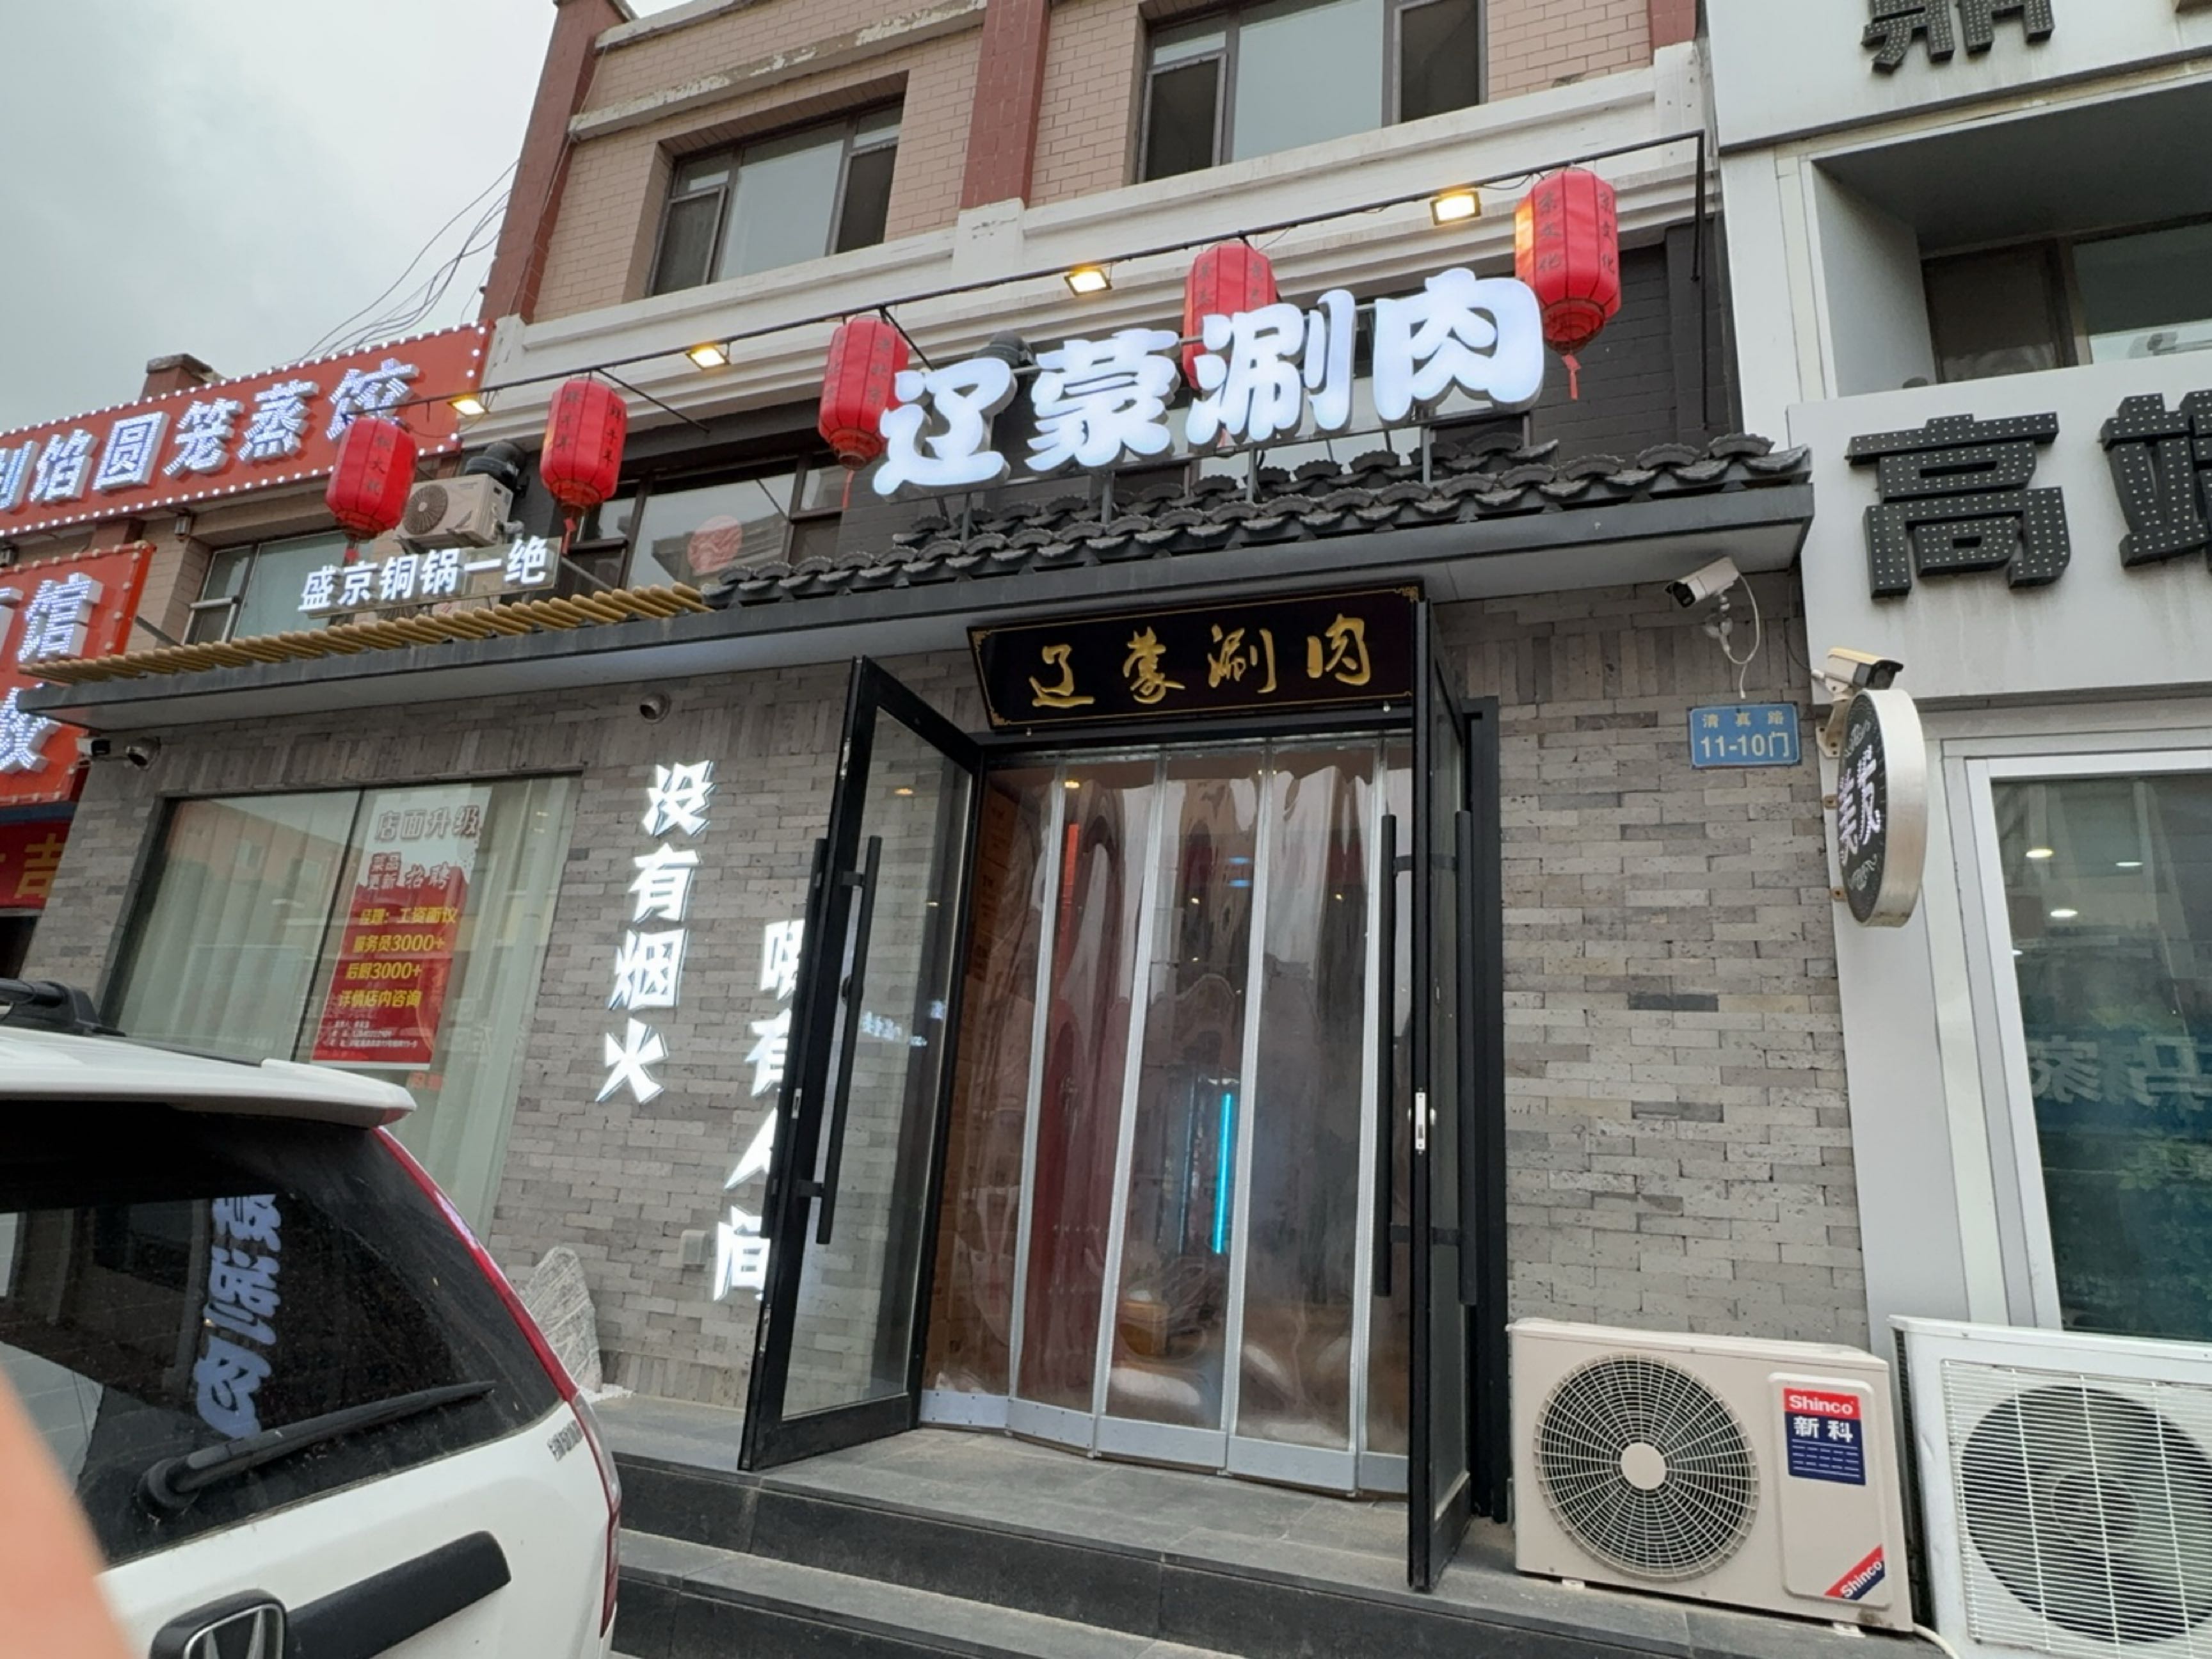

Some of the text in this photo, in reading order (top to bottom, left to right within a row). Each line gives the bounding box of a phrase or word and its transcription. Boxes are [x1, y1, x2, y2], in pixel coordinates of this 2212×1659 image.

[873, 268, 1543, 494] 辽蒙涮肉
[298, 535, 549, 611] 盛京铜锅一绝
[1030, 613, 1372, 708] 辽蒙涮肉
[1700, 731, 1790, 758] 11-10门
[374, 805, 481, 842] 店面升级
[595, 760, 715, 1103] 没有烟火
[1788, 1395, 1854, 1415] Shinco
[1793, 1416, 1853, 1443] 新科
[1839, 1560, 1883, 1598] Shinco
